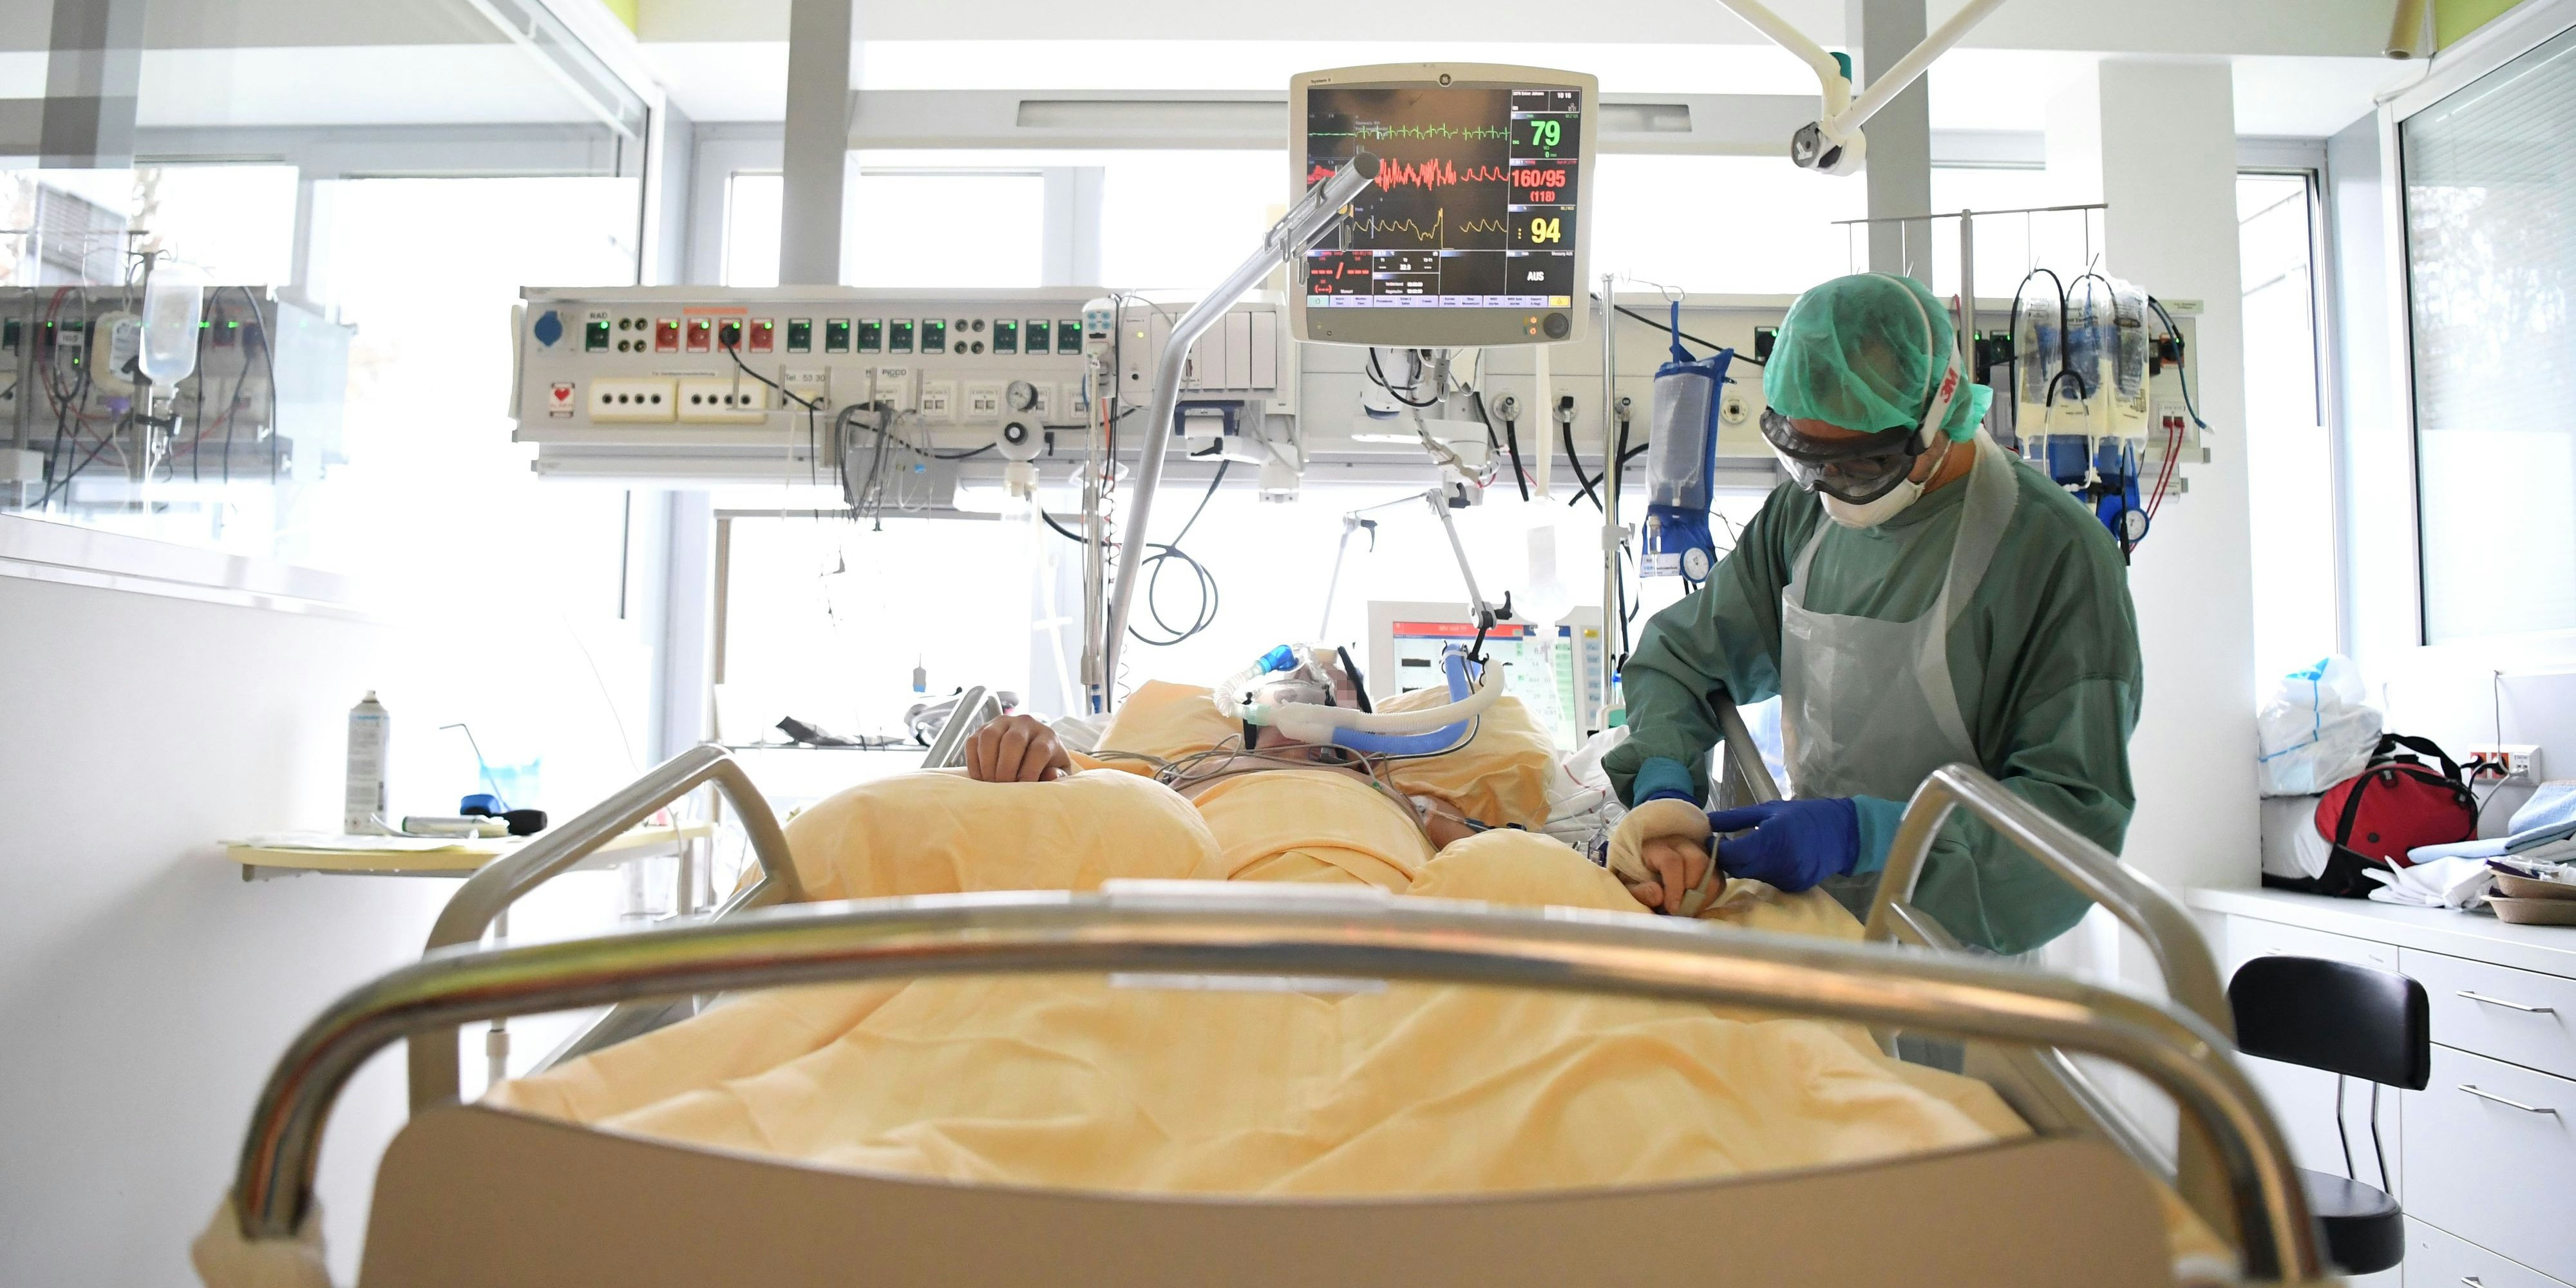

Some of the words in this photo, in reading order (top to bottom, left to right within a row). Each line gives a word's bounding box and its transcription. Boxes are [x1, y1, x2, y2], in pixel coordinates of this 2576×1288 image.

[1530, 120, 1560, 146] 79
[1511, 169, 1566, 187] 160/95
[1530, 191, 1555, 202] (118)
[1531, 218, 1561, 243] 94
[1527, 271, 1544, 281] AUS
[1940, 366, 1958, 404] 3M
